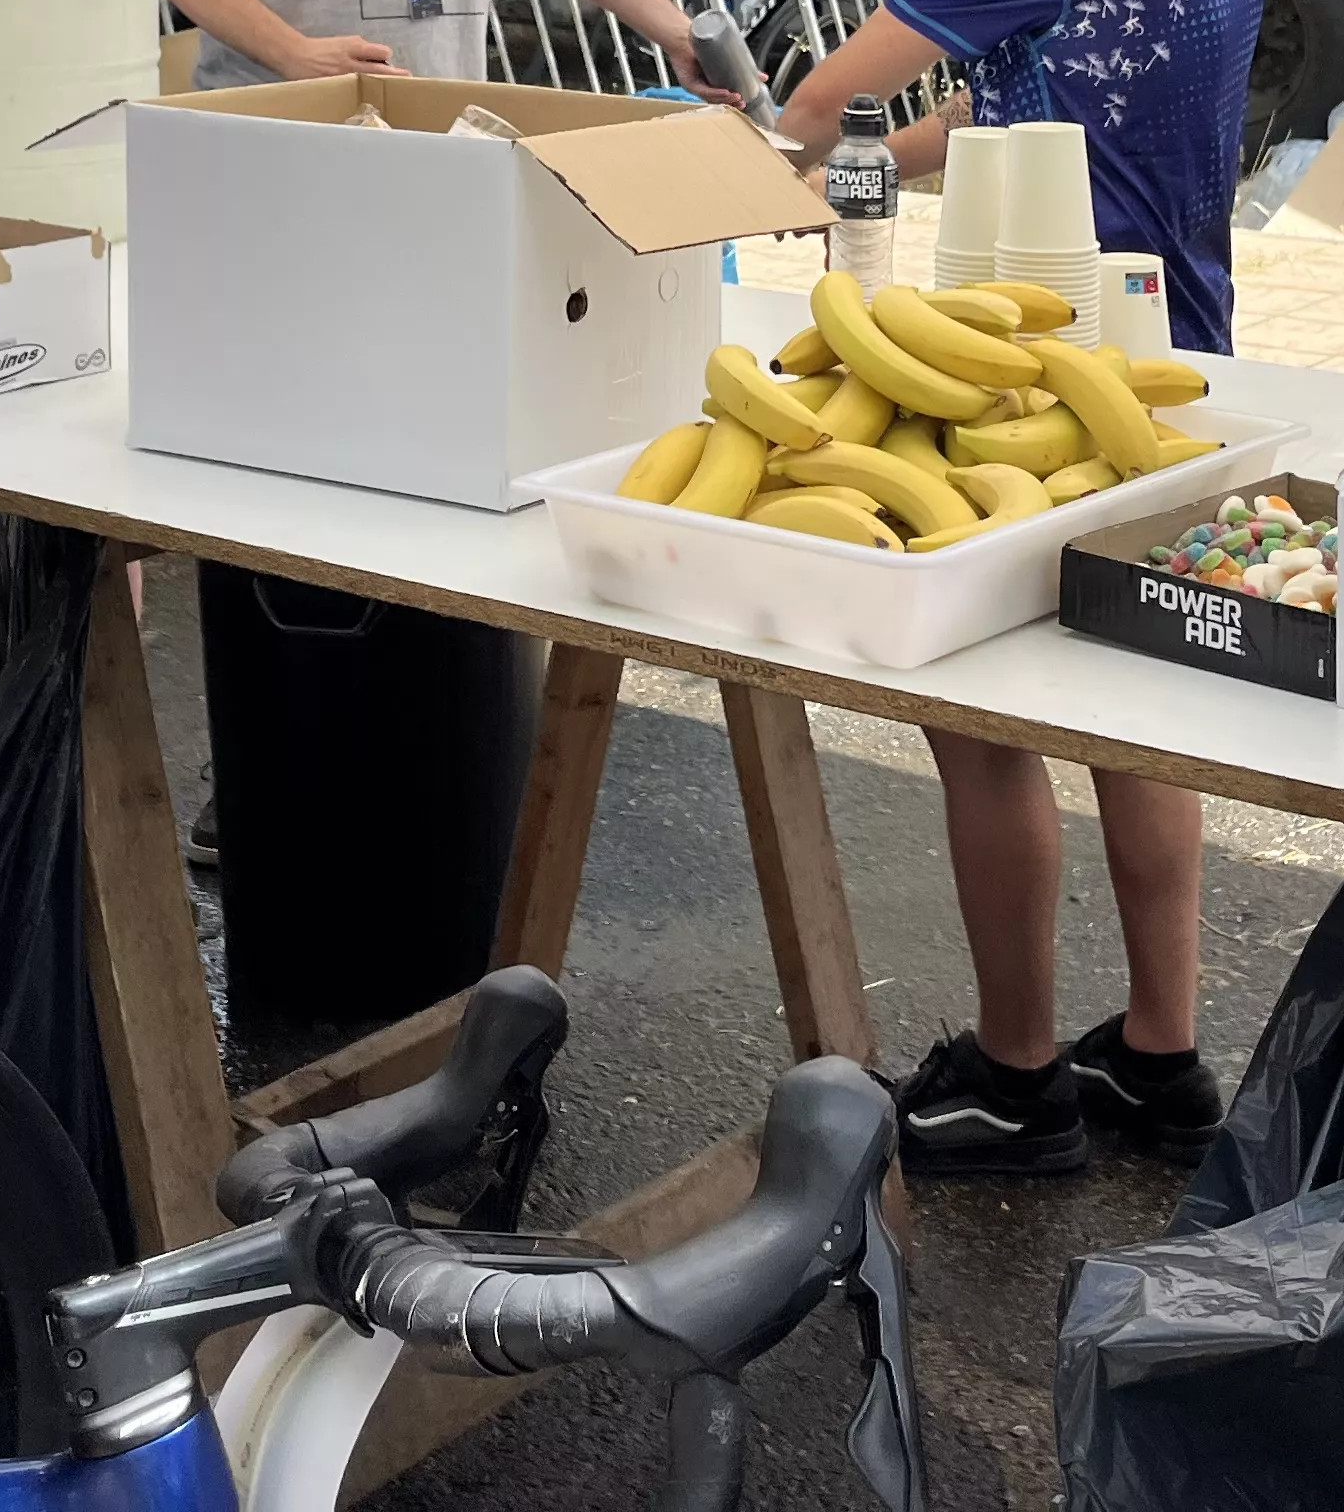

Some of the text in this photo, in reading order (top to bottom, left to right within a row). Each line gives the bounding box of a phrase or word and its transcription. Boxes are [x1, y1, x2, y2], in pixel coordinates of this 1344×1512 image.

[828, 169, 882, 185] POWER
[850, 184, 883, 199] ADE
[1140, 577, 1243, 628] POWER
[1185, 616, 1244, 656] ADE
